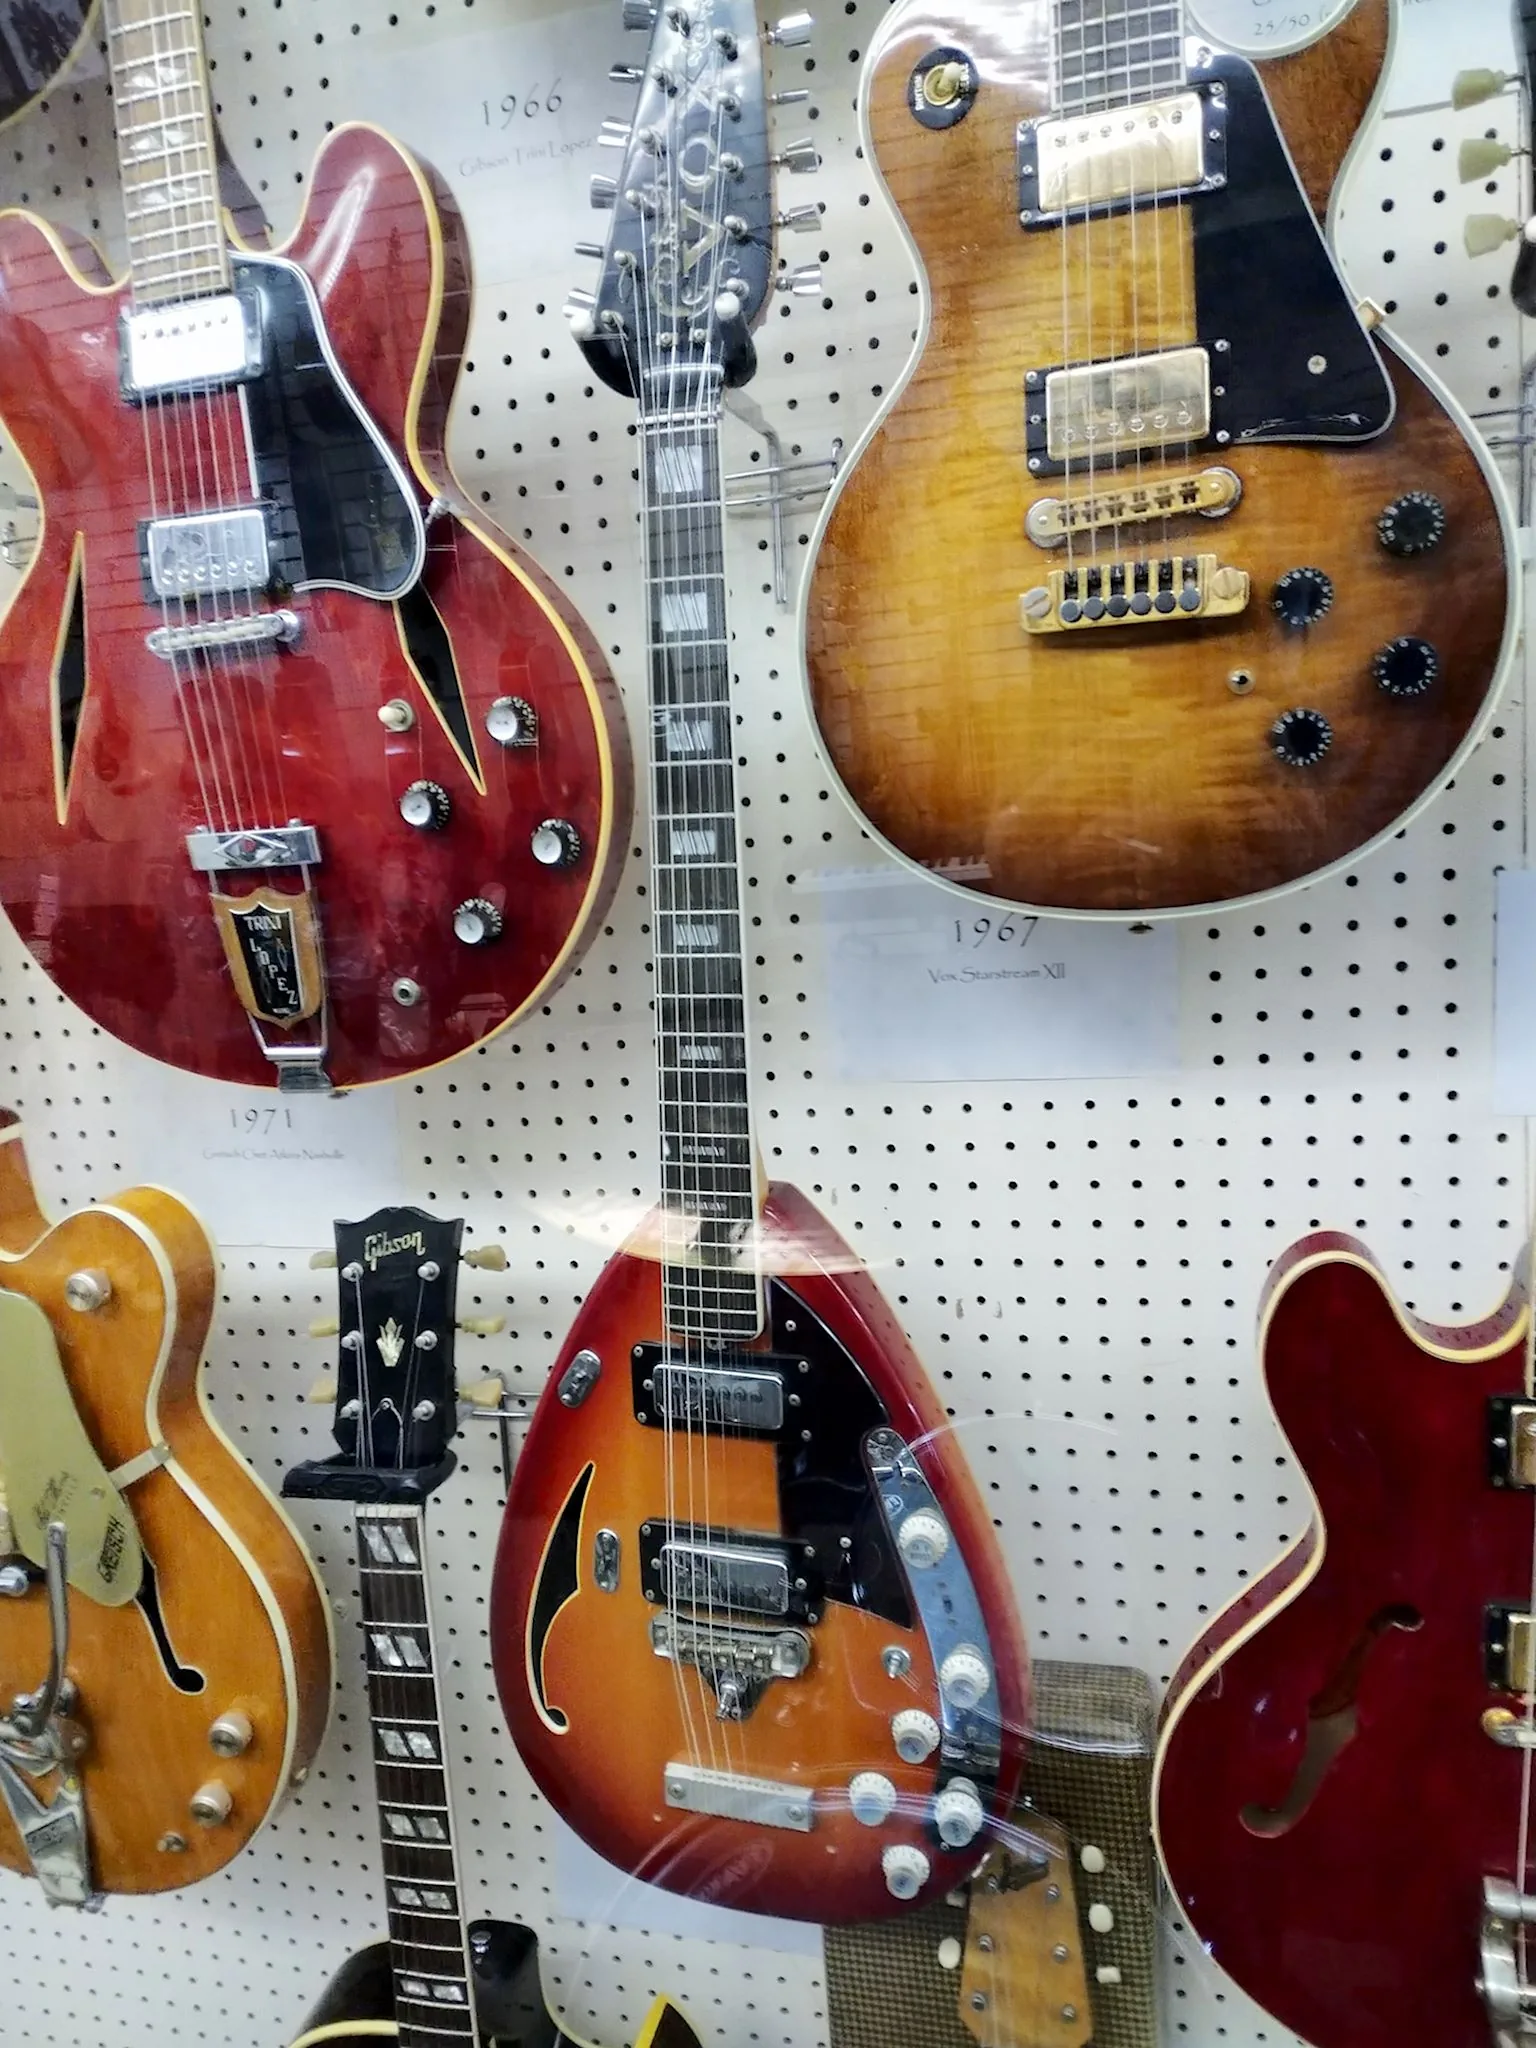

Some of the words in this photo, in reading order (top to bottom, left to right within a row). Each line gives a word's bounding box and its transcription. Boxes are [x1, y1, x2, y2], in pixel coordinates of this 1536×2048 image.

[481, 77, 562, 130] 1966
[242, 915, 283, 931] TRINI
[954, 911, 1040, 949] 1967
[249, 937, 299, 1005] LOPEZ
[958, 966, 1040, 984] Starstream
[1042, 961, 1066, 980] XII
[230, 1108, 293, 1135] 1971
[364, 1230, 426, 1271] Gibson
